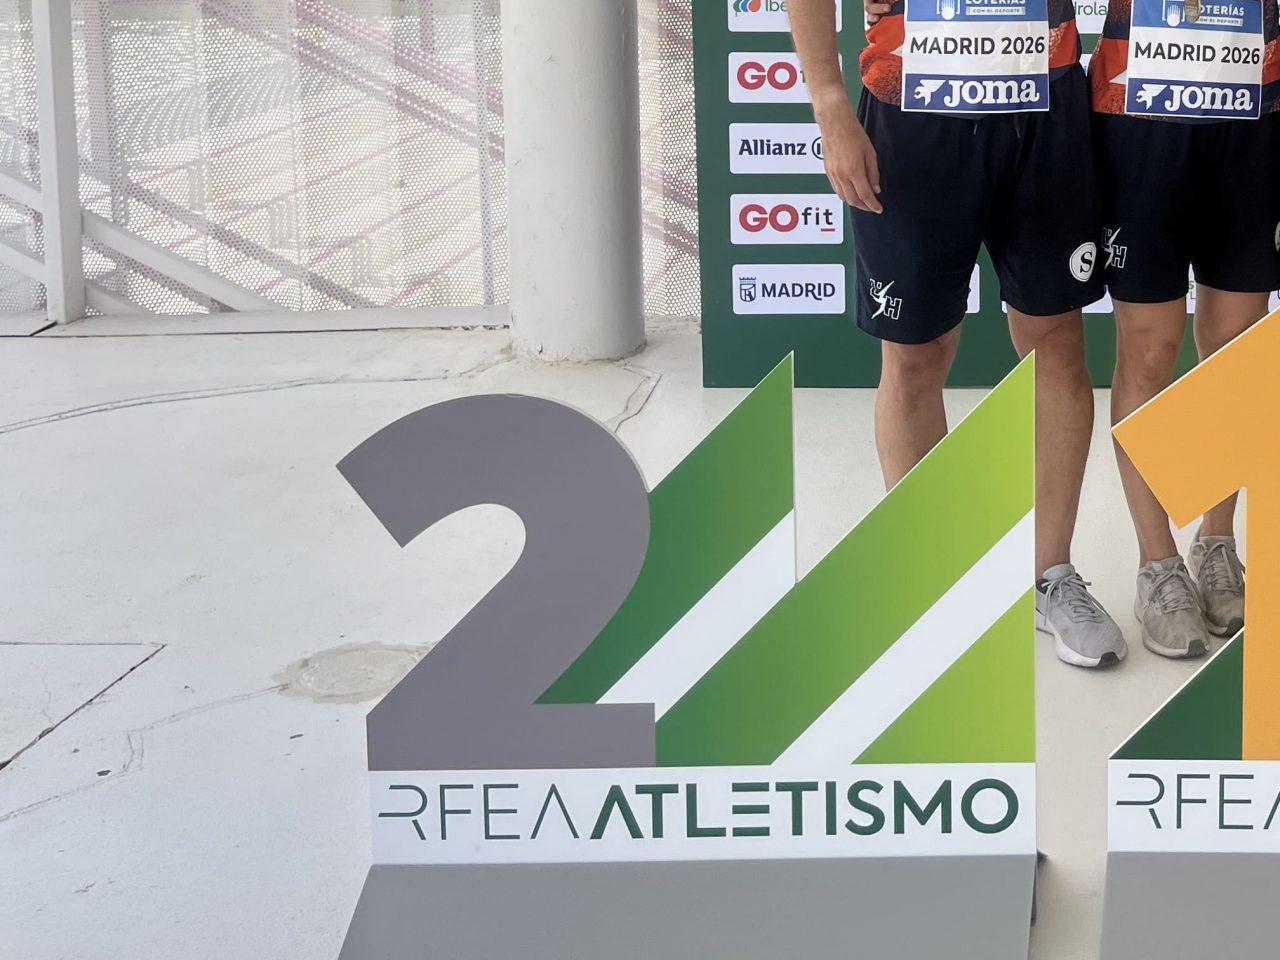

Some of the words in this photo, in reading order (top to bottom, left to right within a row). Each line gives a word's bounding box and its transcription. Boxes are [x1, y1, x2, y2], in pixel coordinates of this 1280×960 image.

[910, 37, 995, 55] MADRID
[1001, 37, 1045, 54] 2026
[1134, 41, 1216, 62] MADRID
[1221, 46, 1260, 64] 2026
[739, 139, 807, 155] Allianz
[761, 283, 836, 300] MADRID
[336, 394, 657, 771] 2
[378, 784, 581, 840] RFEA
[589, 778, 1019, 839] ATLETISMO
